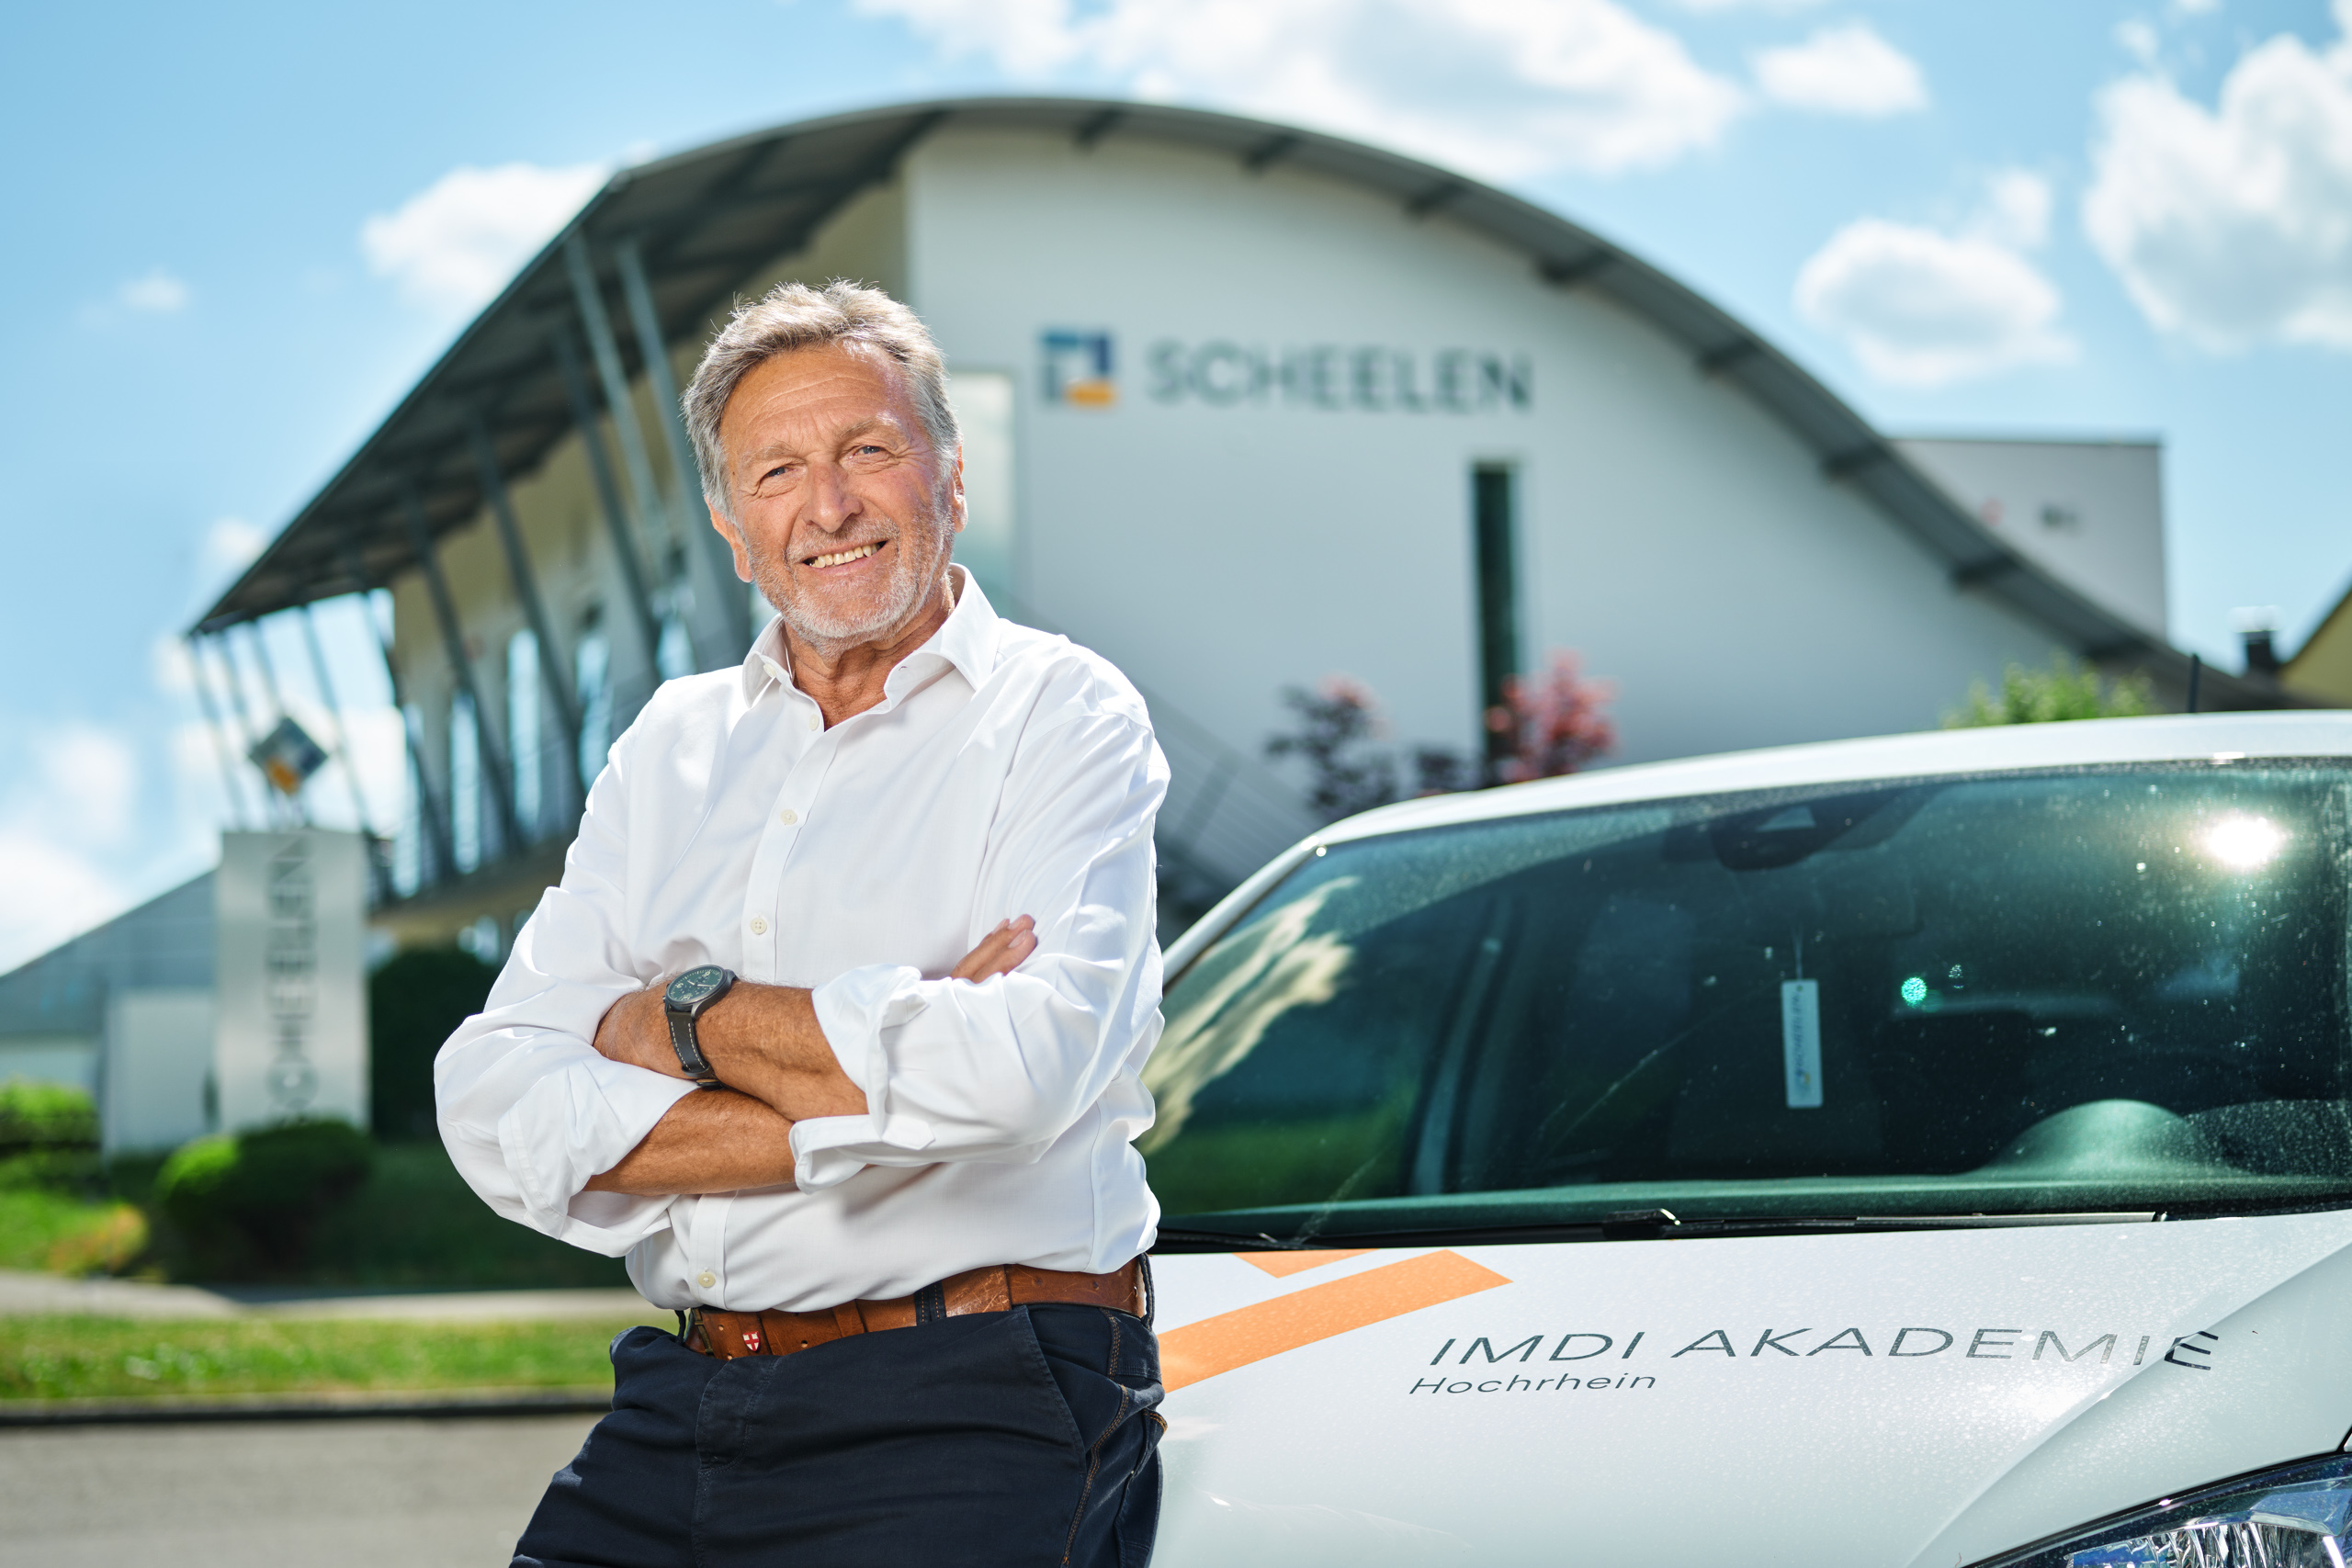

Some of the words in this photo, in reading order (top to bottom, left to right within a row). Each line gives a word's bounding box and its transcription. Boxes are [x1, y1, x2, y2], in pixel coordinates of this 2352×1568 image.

[1145, 339, 1532, 413] SCHEELEN
[1430, 1332, 1645, 1366] IMDI
[1669, 1328, 2219, 1371] AKADEMIE
[1408, 1372, 1657, 1395] Hochrhein
